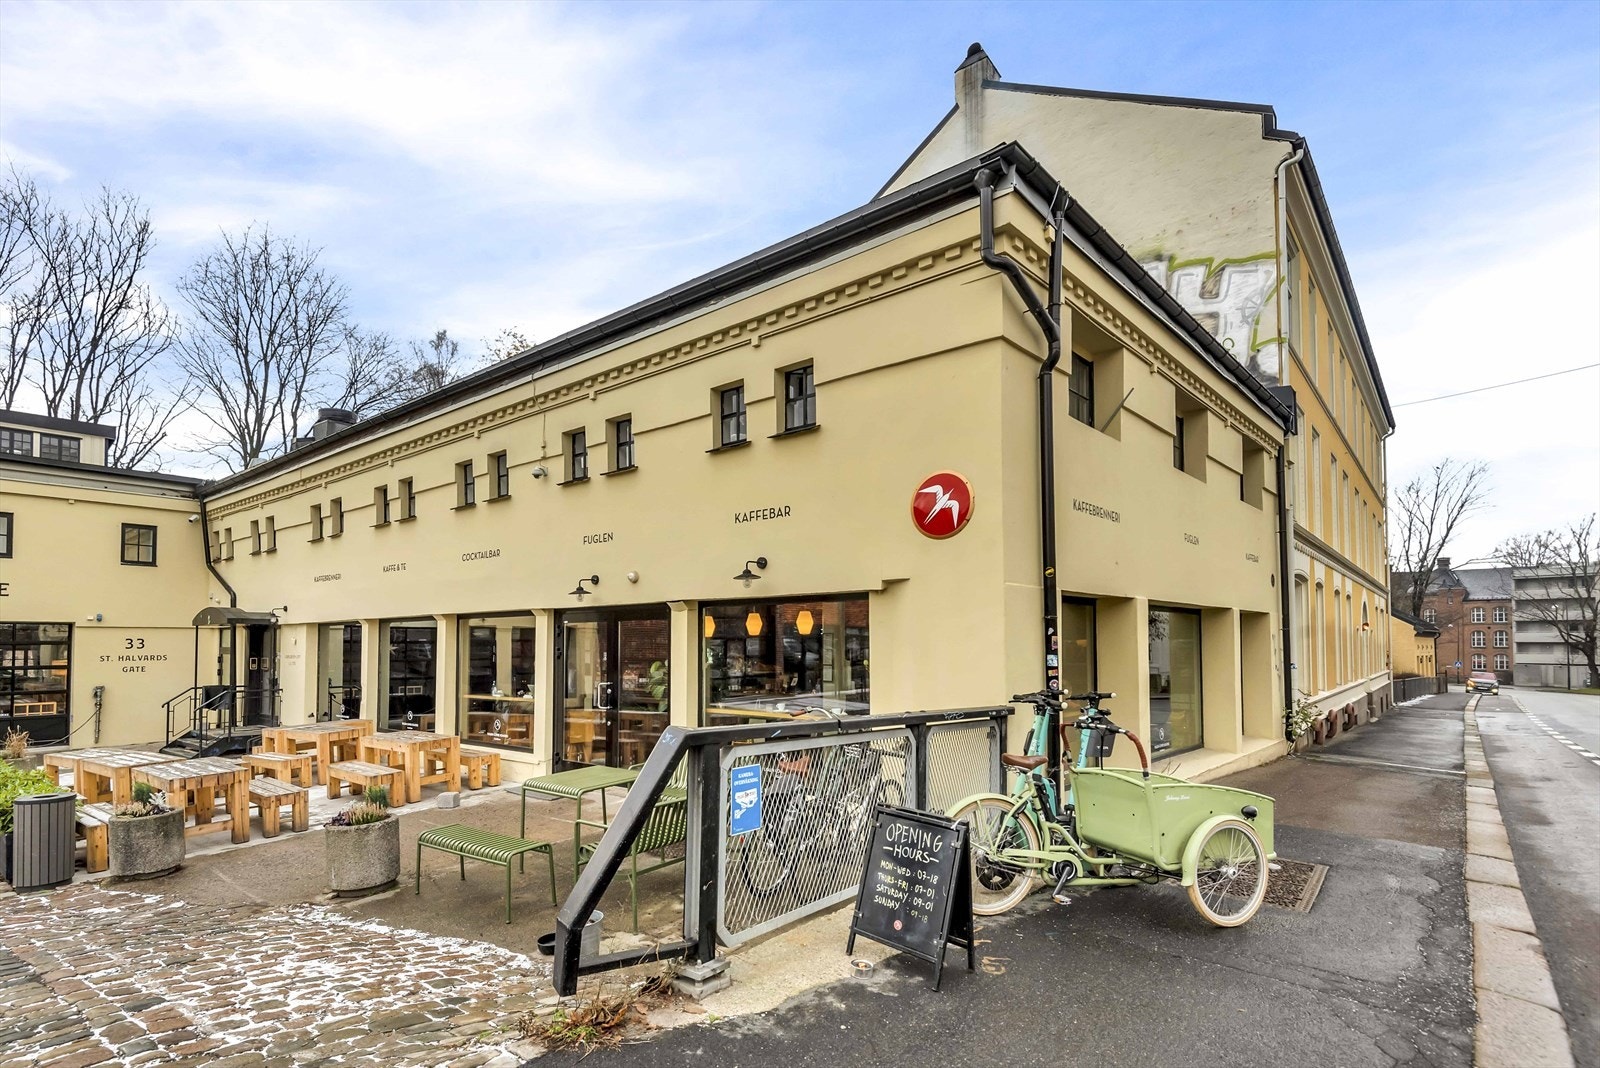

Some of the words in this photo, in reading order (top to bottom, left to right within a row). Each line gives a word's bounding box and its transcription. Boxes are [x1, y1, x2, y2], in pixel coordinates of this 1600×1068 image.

[734, 505, 791, 524] KAFFEBAR
[1073, 498, 1120, 523] KAFFEBRENNERI
[583, 532, 613, 545] FUGLEN
[462, 549, 500, 562] COCKTAILBAR
[383, 564, 396, 572] KAFFE
[401, 562, 407, 571] TE
[125, 638, 145, 649] 33
[118, 654, 168, 662] HALVARDS
[885, 823, 943, 853] OPENING
[876, 883, 909, 903] SATURDAY
